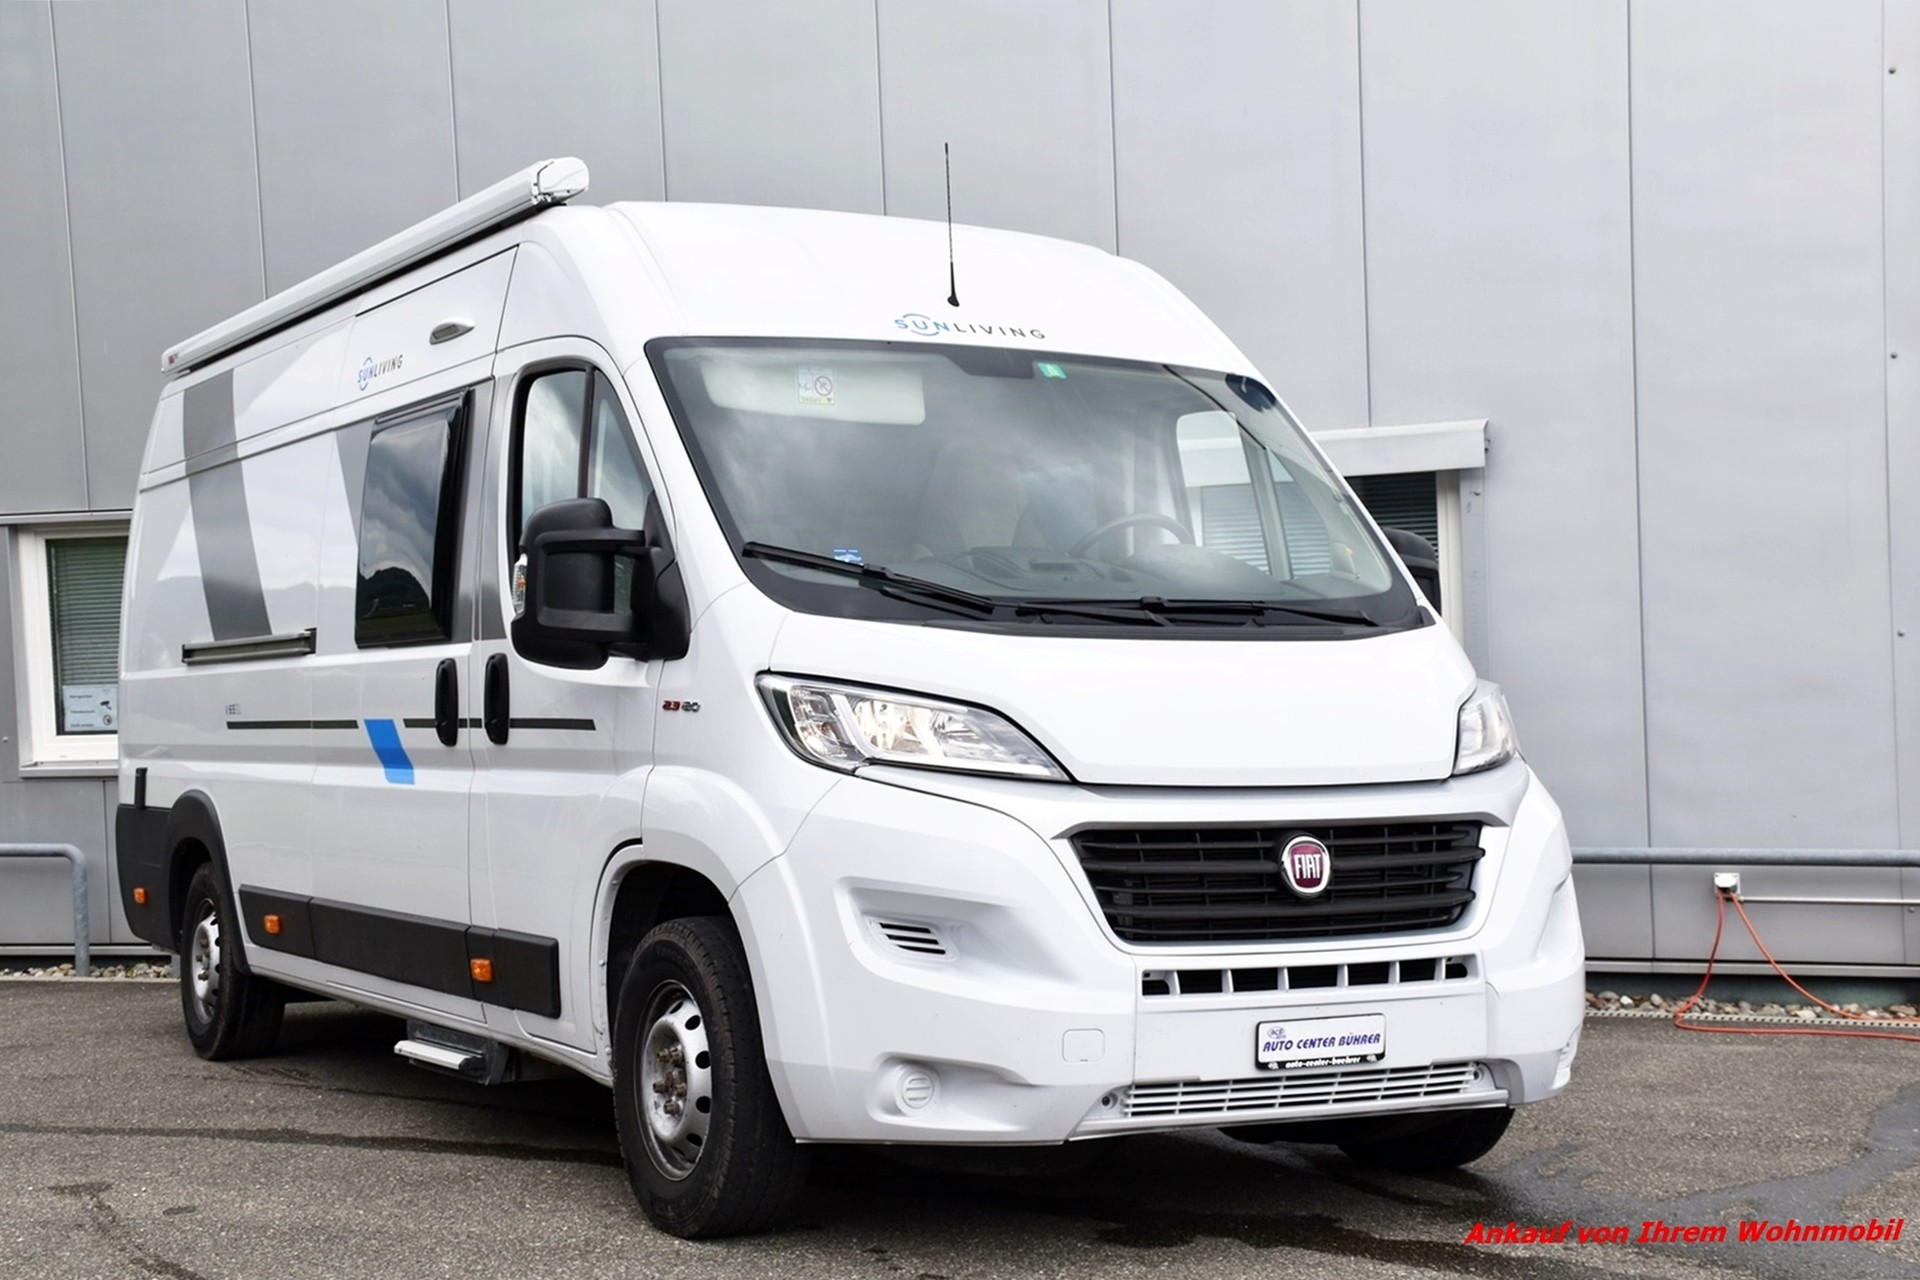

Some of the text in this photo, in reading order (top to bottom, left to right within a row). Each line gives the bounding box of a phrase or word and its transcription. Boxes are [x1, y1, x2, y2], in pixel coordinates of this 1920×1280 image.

[895, 314, 1046, 340] SUNLIVING
[1293, 853, 1321, 880] FIAT
[1262, 1031, 1382, 1053] AUTO CENTER BÜHRER
